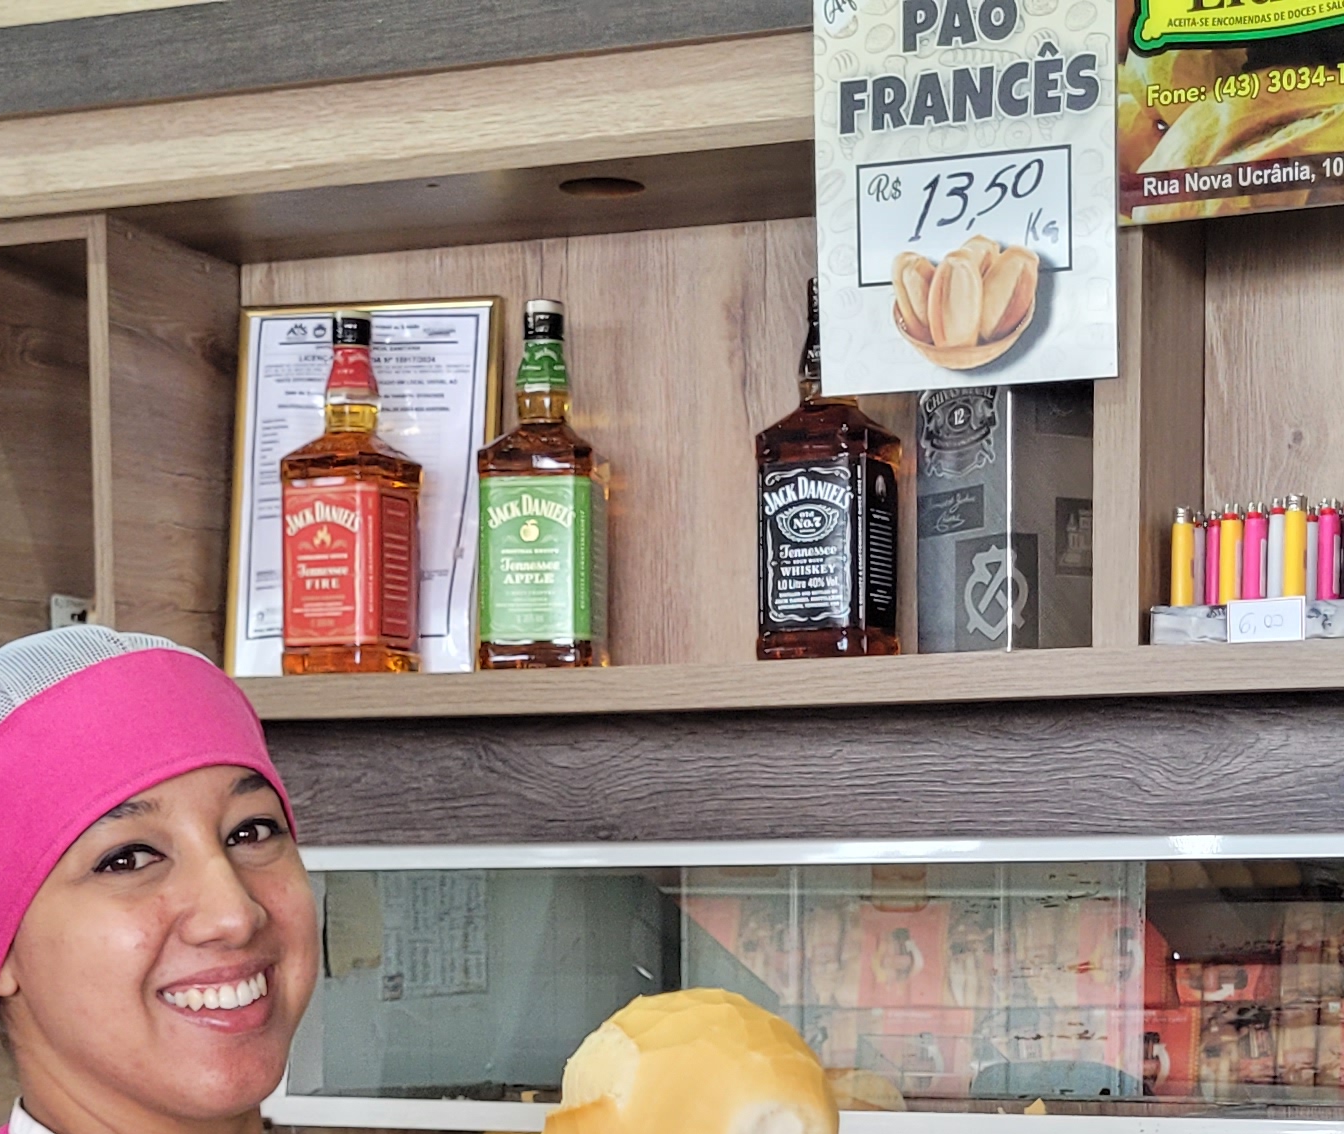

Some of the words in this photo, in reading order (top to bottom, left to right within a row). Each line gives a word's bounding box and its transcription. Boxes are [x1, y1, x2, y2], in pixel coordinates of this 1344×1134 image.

[1167, 16, 1210, 28] ACEITA-SE
[1212, 13, 1272, 27] ENCOMENDAS
[1274, 11, 1285, 22] DE
[1288, 6, 1317, 20] DOCES
[1319, 4, 1325, 13] E
[839, 41, 1100, 134] FRANCÊS
[1147, 83, 1206, 107] Fone:
[1213, 73, 1260, 102] (43)
[1143, 176, 1180, 197] Rua
[1185, 171, 1233, 193] Nova
[1238, 161, 1316, 188] Ucrânia,
[868, 173, 902, 202] R$
[908, 158, 1044, 242] 13,50
[953, 407, 965, 426] 12
[763, 483, 796, 515] JACK
[286, 508, 315, 536] JACK
[487, 500, 521, 529] JACK
[779, 544, 838, 559] Tennessee
[500, 557, 560, 572] Tennessee
[780, 563, 836, 577] WHISKEY
[305, 578, 340, 590] FIRE
[503, 573, 555, 585] APPLE
[808, 577, 826, 589] 40%
